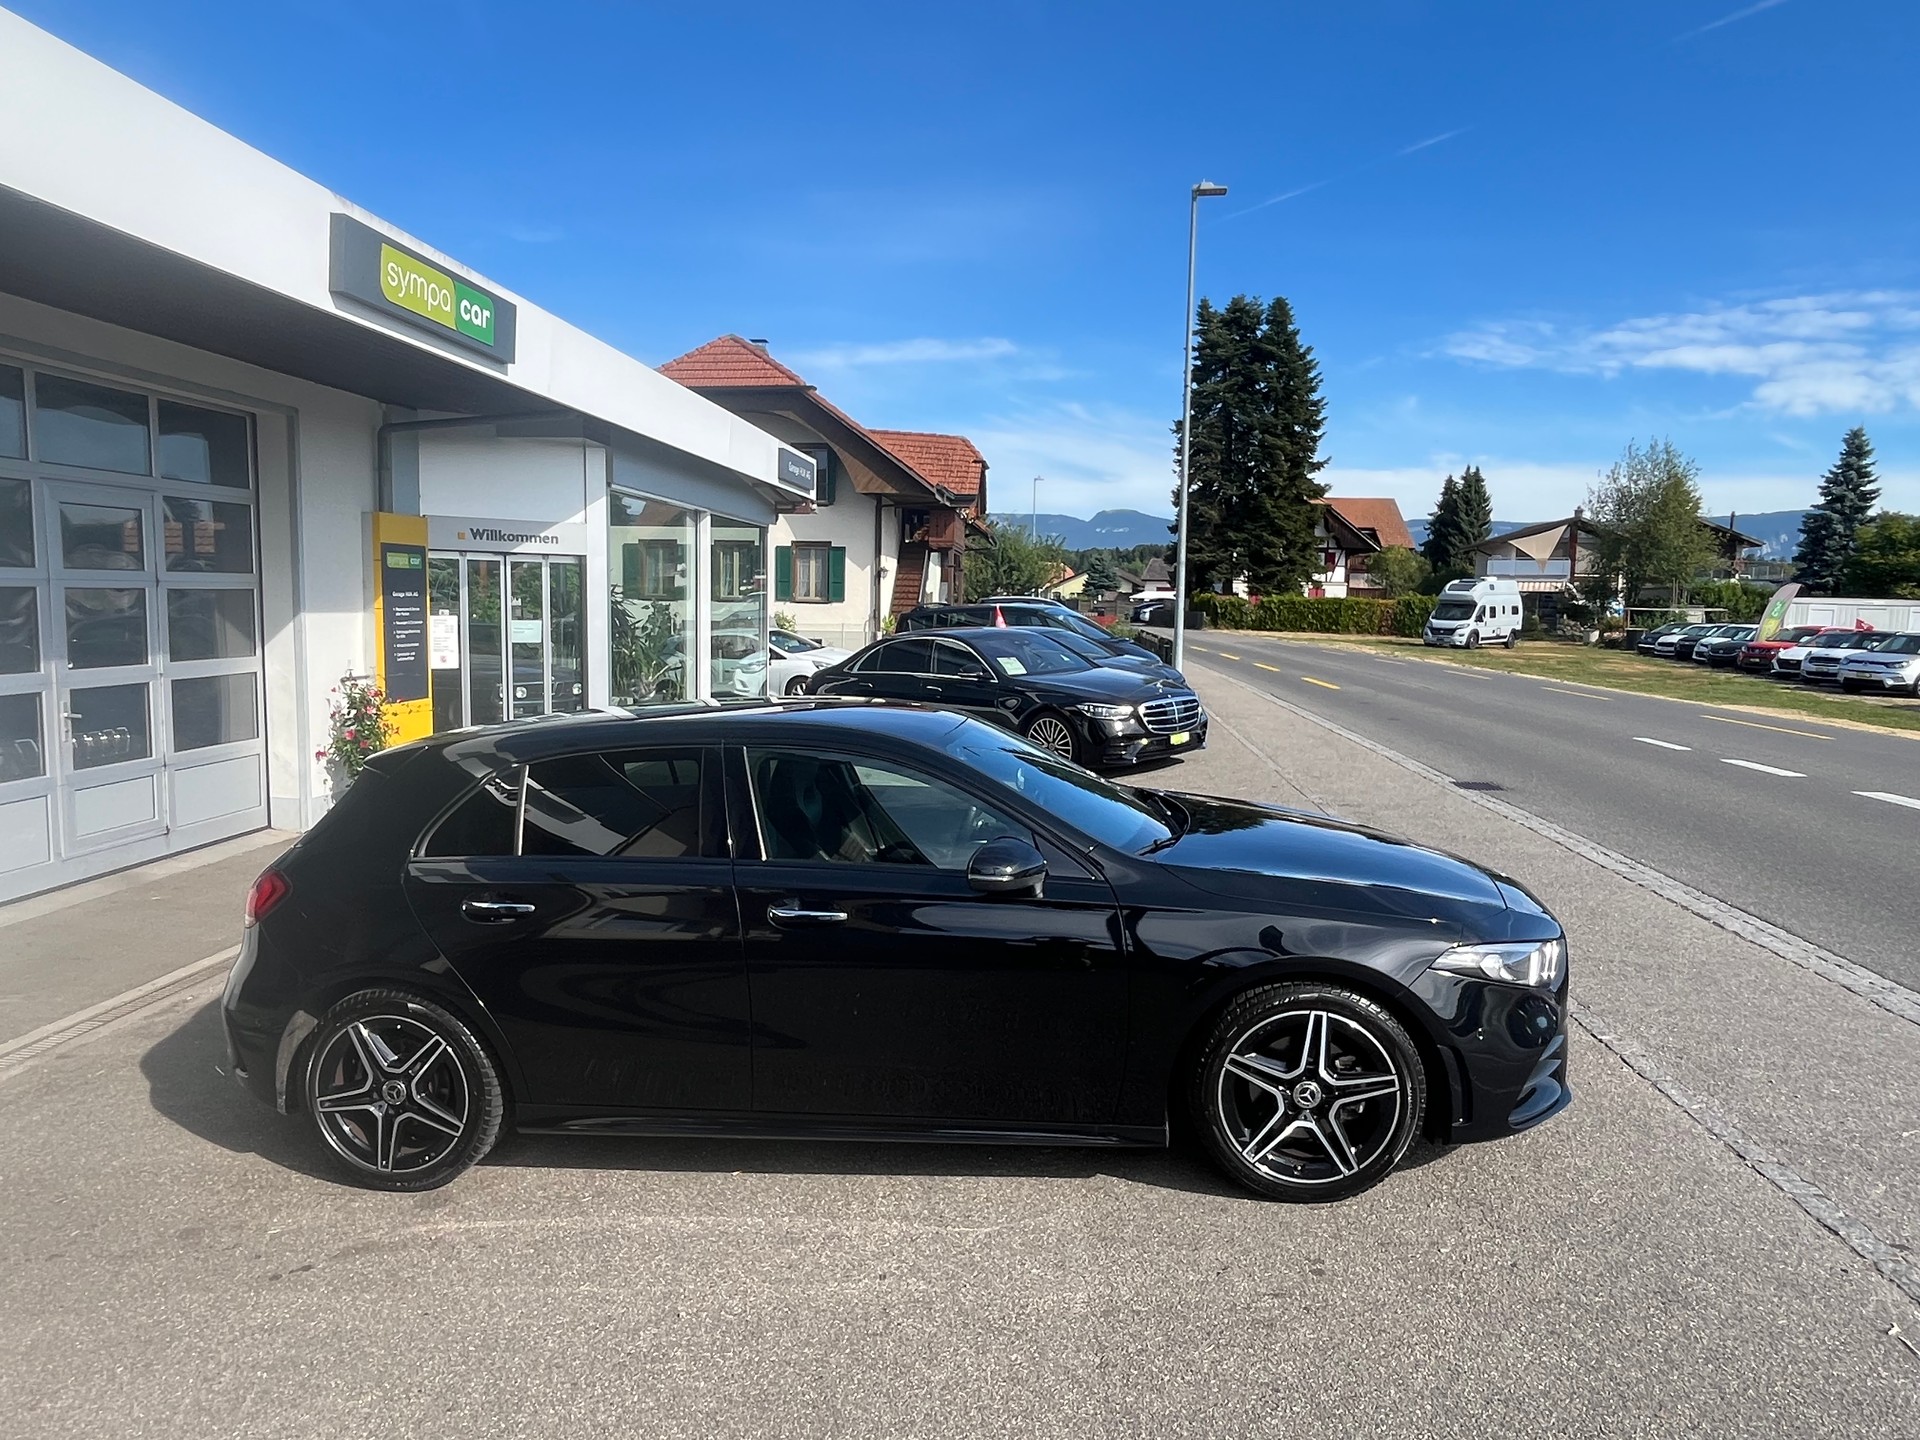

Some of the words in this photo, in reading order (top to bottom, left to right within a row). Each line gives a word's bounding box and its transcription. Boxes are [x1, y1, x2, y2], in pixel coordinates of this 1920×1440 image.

[387, 262, 452, 312] sympa
[460, 299, 490, 328] car
[469, 527, 559, 544] Willkommen
